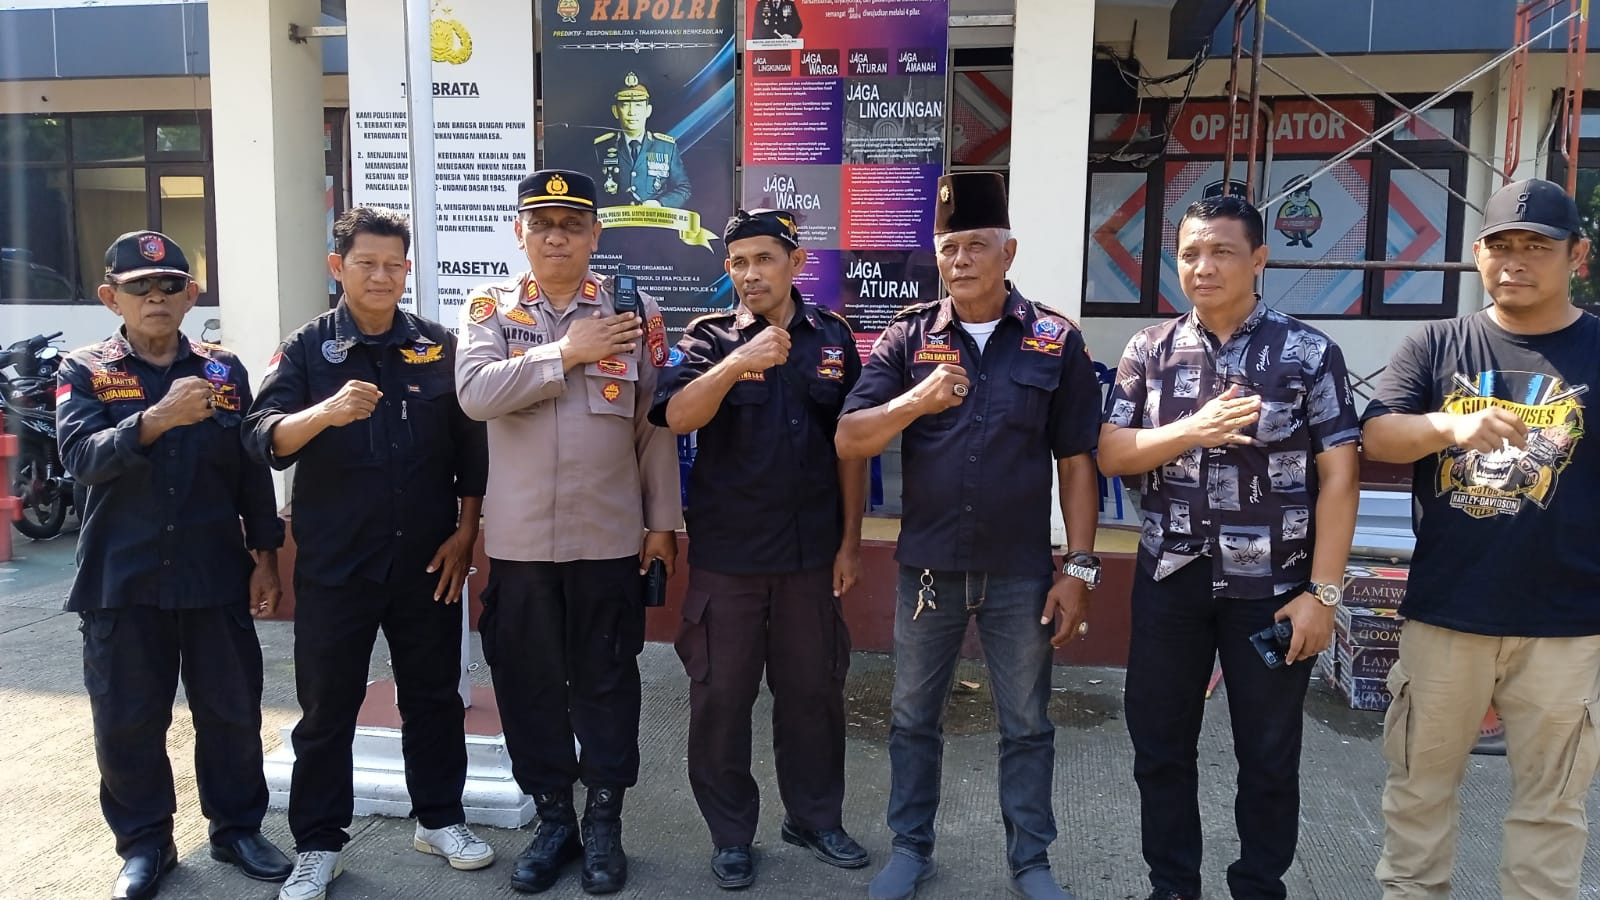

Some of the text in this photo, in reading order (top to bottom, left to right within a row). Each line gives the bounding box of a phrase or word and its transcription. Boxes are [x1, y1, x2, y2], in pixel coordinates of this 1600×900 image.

[591, 0, 720, 21] KAPOLRI
[801, 53, 821, 64] JAGA
[849, 53, 868, 64] JAGA
[898, 52, 917, 62] JAGA
[809, 64, 838, 75] WARGA
[856, 63, 887, 73] ATURAN
[905, 62, 936, 72] AMANAH
[846, 83, 880, 101] JAGA
[859, 101, 942, 119] LINGKUNGAN
[479, 152, 509, 160] KEADILAN
[502, 163, 526, 171] NEGARA
[763, 175, 795, 192] JAGA
[776, 193, 821, 209] WARGA
[846, 260, 882, 279] JAGA
[859, 280, 919, 299] ATURAN
[503, 327, 544, 344] URTONO
[1470, 486, 1499, 496] MOTOR
[1453, 494, 1517, 510] HARLEY-DAVIDSON
